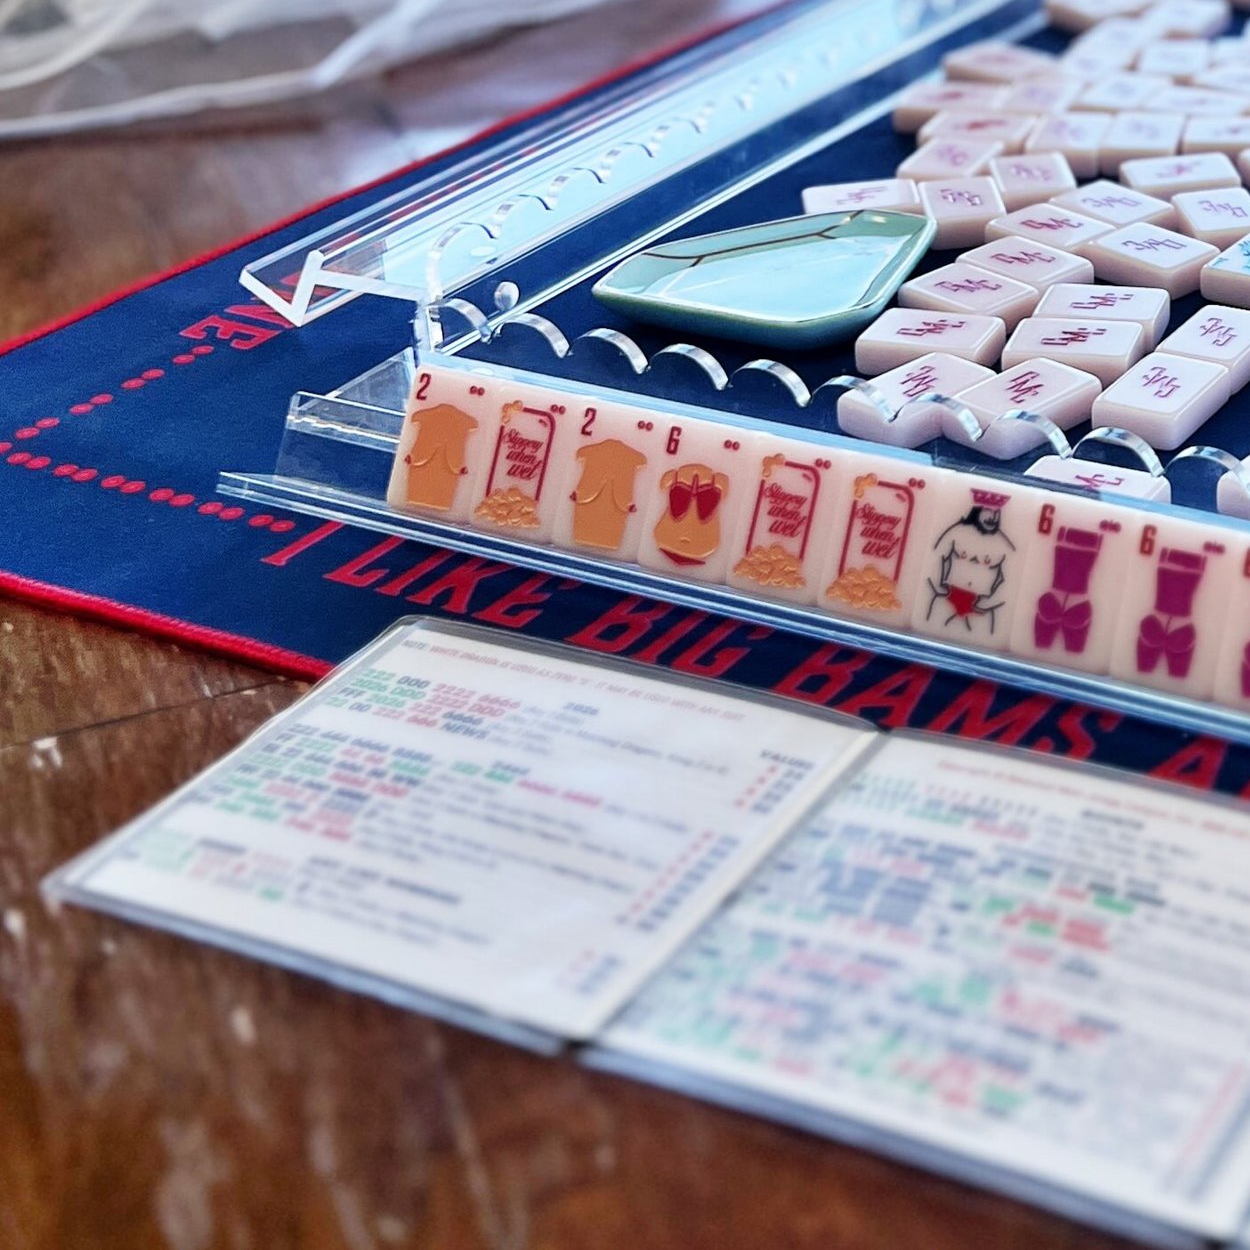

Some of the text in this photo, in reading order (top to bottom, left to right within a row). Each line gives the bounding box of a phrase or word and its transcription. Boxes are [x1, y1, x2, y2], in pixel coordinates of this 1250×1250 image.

[416, 373, 431, 400] 2
[581, 407, 596, 435] 2
[666, 426, 682, 454] 6
[506, 448, 538, 465] when
[506, 458, 543, 480] wet
[767, 504, 802, 522] when
[1038, 503, 1055, 534] 6
[769, 515, 806, 538] wet
[860, 525, 894, 542] when
[862, 537, 900, 559] wet
[1140, 524, 1157, 555] 6
[261, 521, 345, 566] I
[323, 536, 584, 628] LIKE
[565, 594, 776, 678] BIG
[773, 642, 1122, 761] BAMS
[439, 723, 491, 739] NEWS
